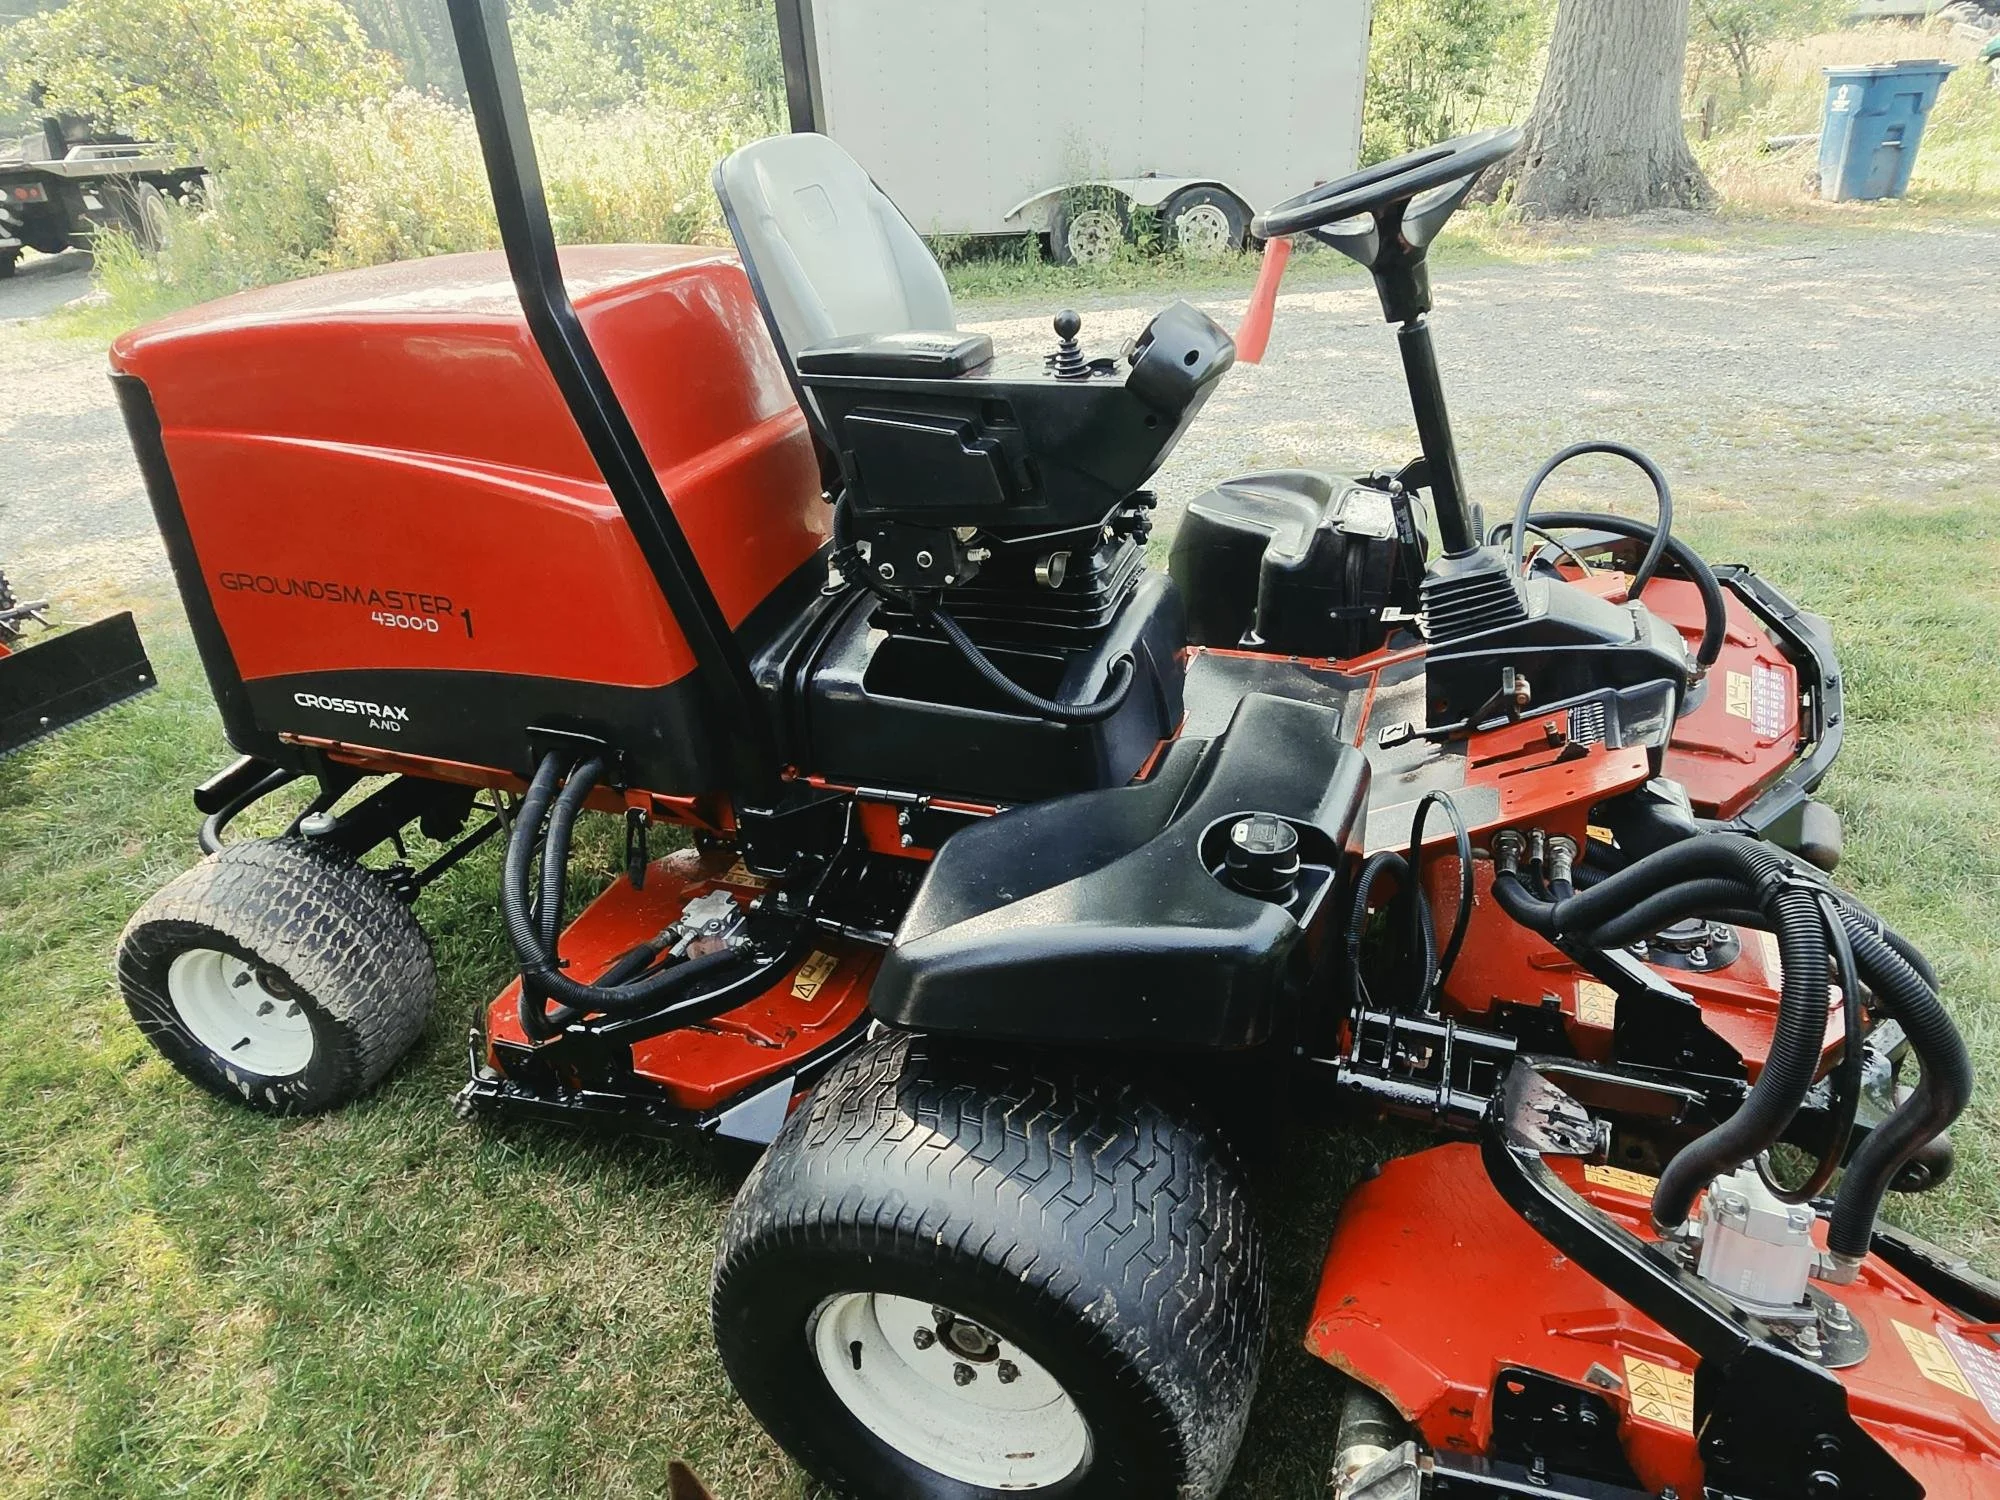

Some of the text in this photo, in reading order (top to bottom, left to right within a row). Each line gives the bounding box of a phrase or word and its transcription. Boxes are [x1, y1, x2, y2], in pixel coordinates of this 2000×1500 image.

[220, 572, 453, 615] GROUNDSMASTER
[460, 608, 473, 638] 1
[294, 693, 409, 721] CROSSTRAX
